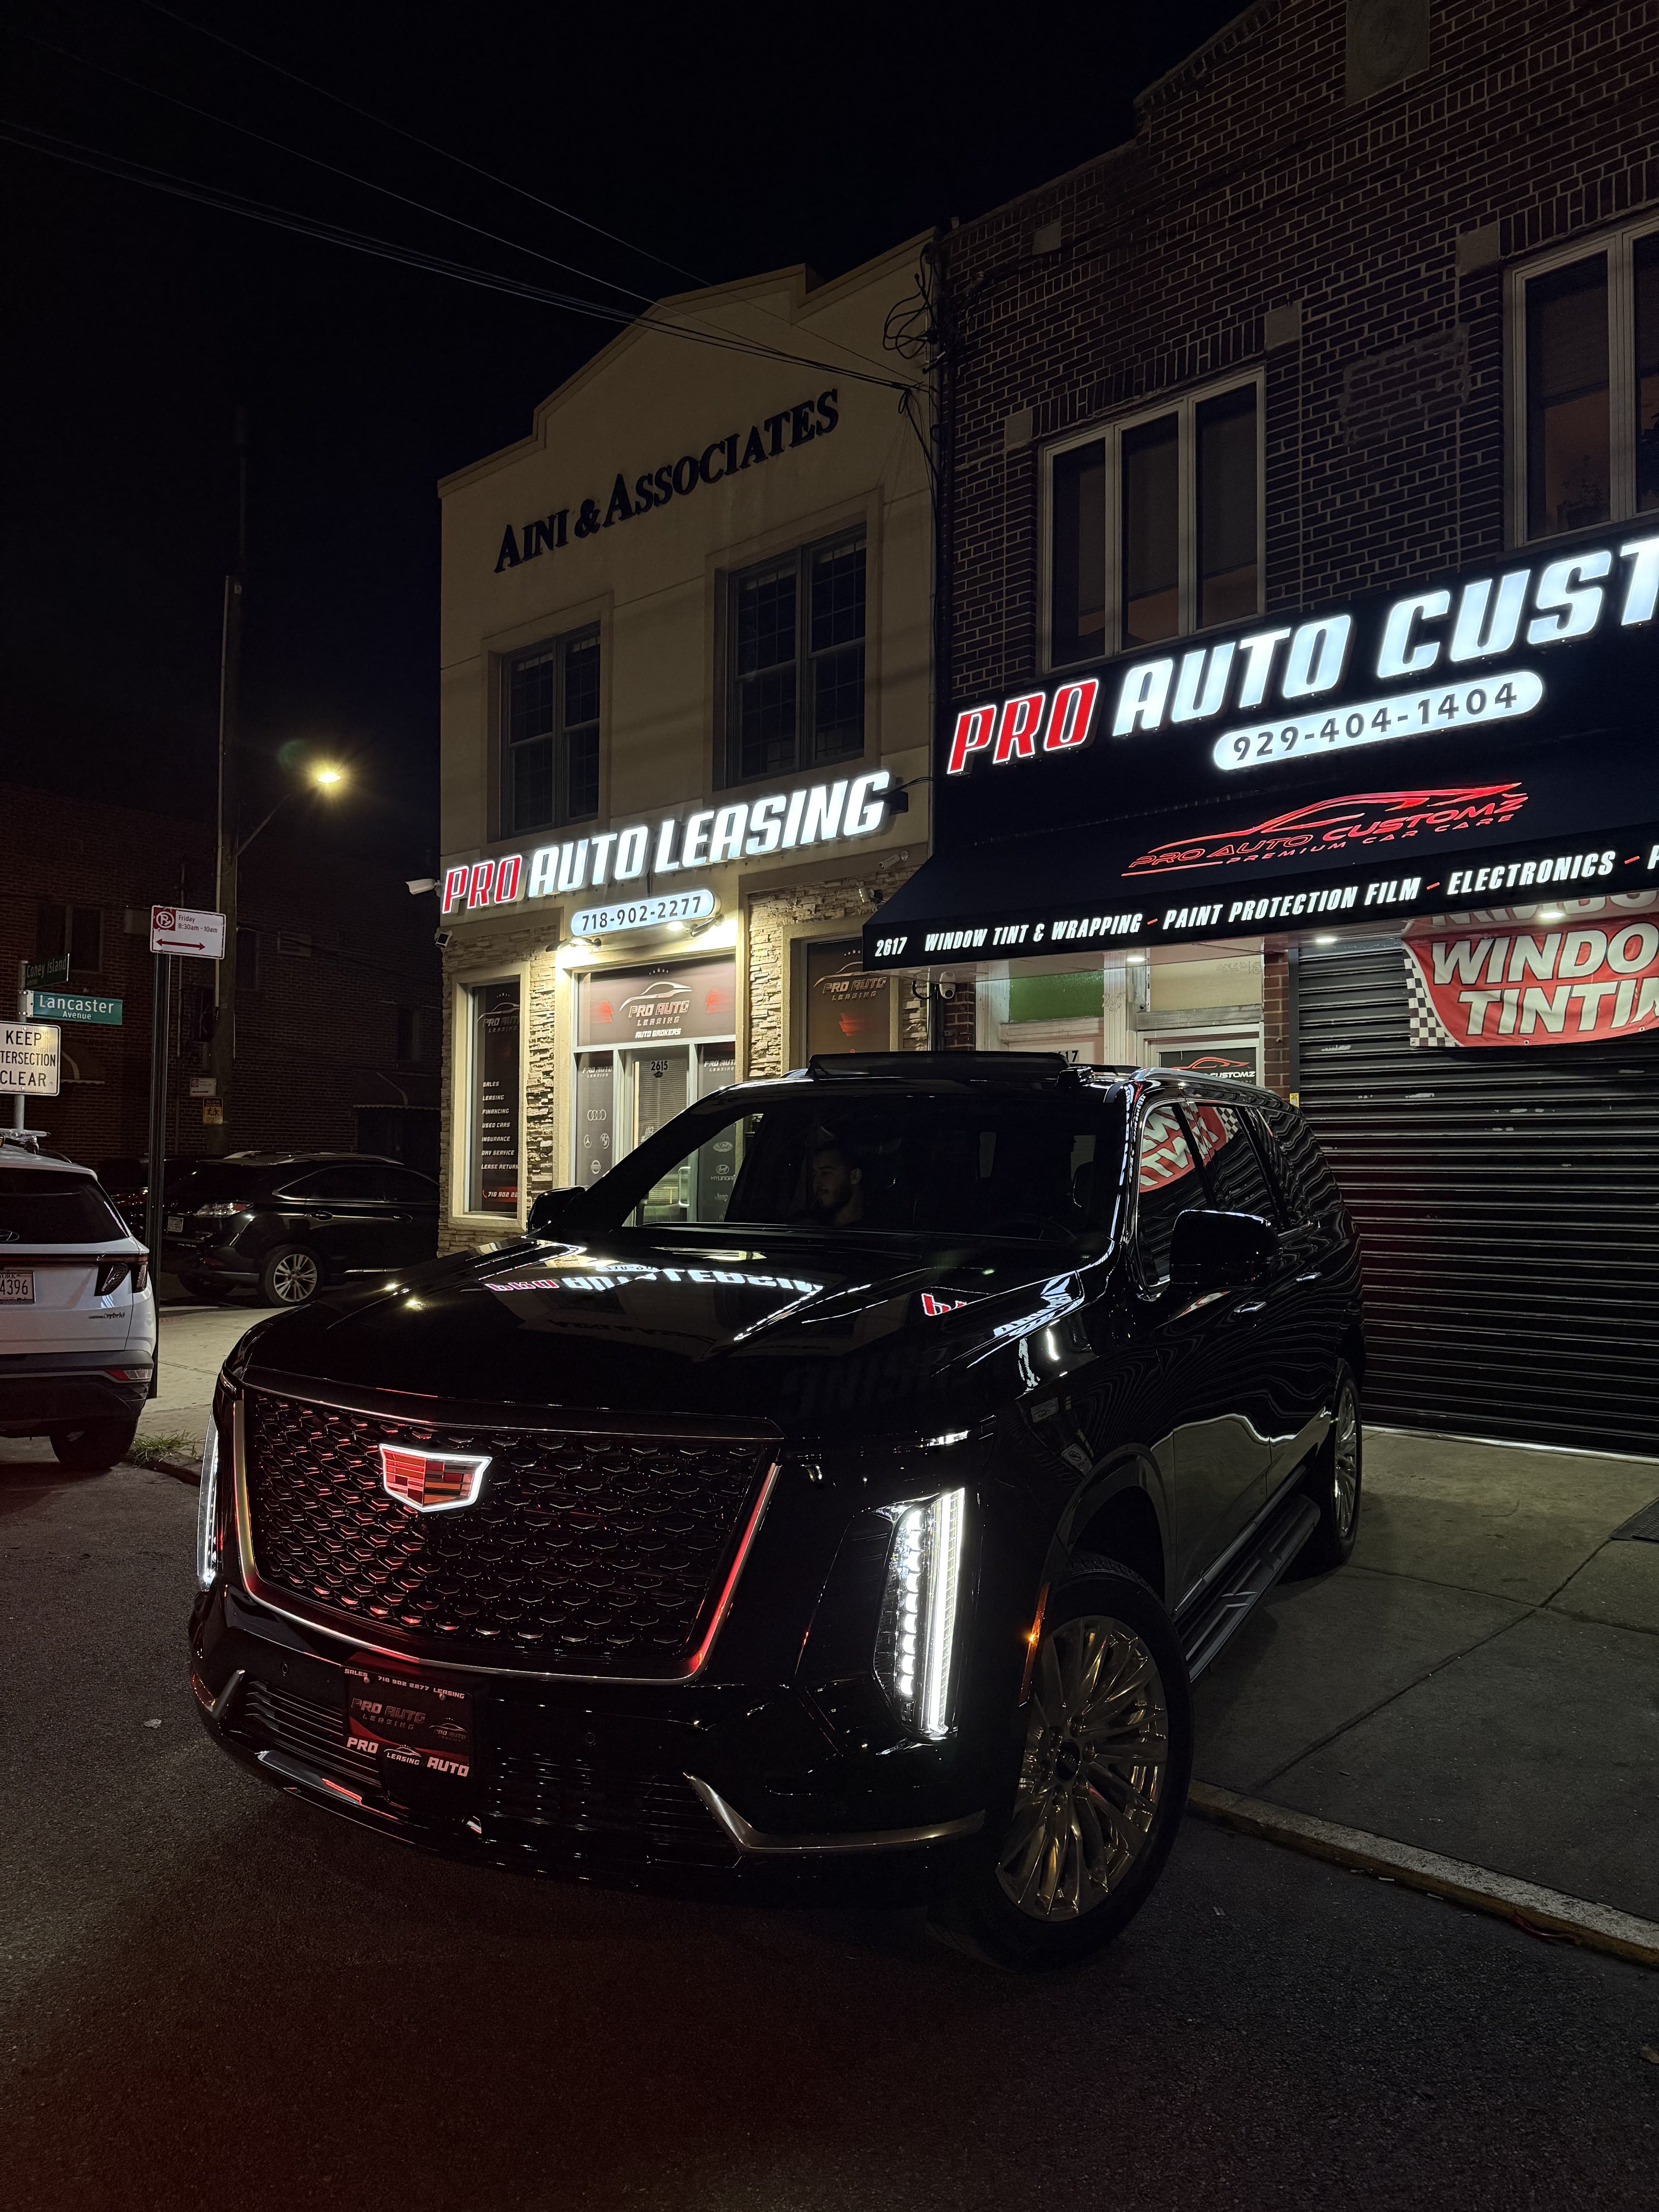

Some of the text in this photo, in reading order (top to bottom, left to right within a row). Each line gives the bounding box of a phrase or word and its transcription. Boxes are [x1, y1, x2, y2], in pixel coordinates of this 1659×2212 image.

[493, 509, 569, 573] AINI
[574, 499, 601, 538] &
[946, 537, 1659, 776] PRO AUTO CUST
[1232, 682, 1518, 762] 929-404-1404
[1128, 797, 1529, 868] PRO AUTO CUSTOMZ
[1226, 814, 1514, 864] PREMIUM CAR CARE
[442, 771, 891, 915] PRO AUTO LEASING
[874, 937, 907, 957] 2617
[925, 928, 988, 951] WINDOW
[992, 924, 1029, 945] TINT
[1033, 923, 1044, 942] &
[1051, 913, 1143, 940] WRAPPING
[1162, 904, 1224, 930] PAINT
[1227, 886, 1358, 923] PROTECTION
[1363, 877, 1421, 906] FILM
[1446, 851, 1616, 895] ELECTRONICS
[582, 897, 701, 932] 718-902-2277
[1432, 922, 1659, 985] WINDO
[27, 964, 45, 979] Coney
[822, 977, 887, 994] PRO AUTO
[39, 995, 114, 1014] Lancaster
[832, 991, 877, 1001] LEASING
[63, 1011, 91, 1020] Avenue
[628, 1000, 690, 1018] PRO AUTO
[483, 1017, 500, 1027] PRO
[636, 1016, 680, 1027] LEASING
[6, 1030, 41, 1046] KEEP
[635, 1028, 682, 1039] AUTO BROKERS
[1058, 1050, 1078, 1062] 17
[651, 1061, 668, 1071] 2615
[0, 1070, 46, 1087] CLEAR
[0, 1279, 28, 1295] 4396
[344, 1669, 368, 1677] SALES
[409, 1683, 429, 1691] 2277
[433, 1687, 465, 1699] LEASING
[351, 1698, 426, 1723] PRO AUTO
[346, 1736, 378, 1754] PRO
[387, 1752, 420, 1765] LEASING
[427, 1756, 469, 1777] AUTO
